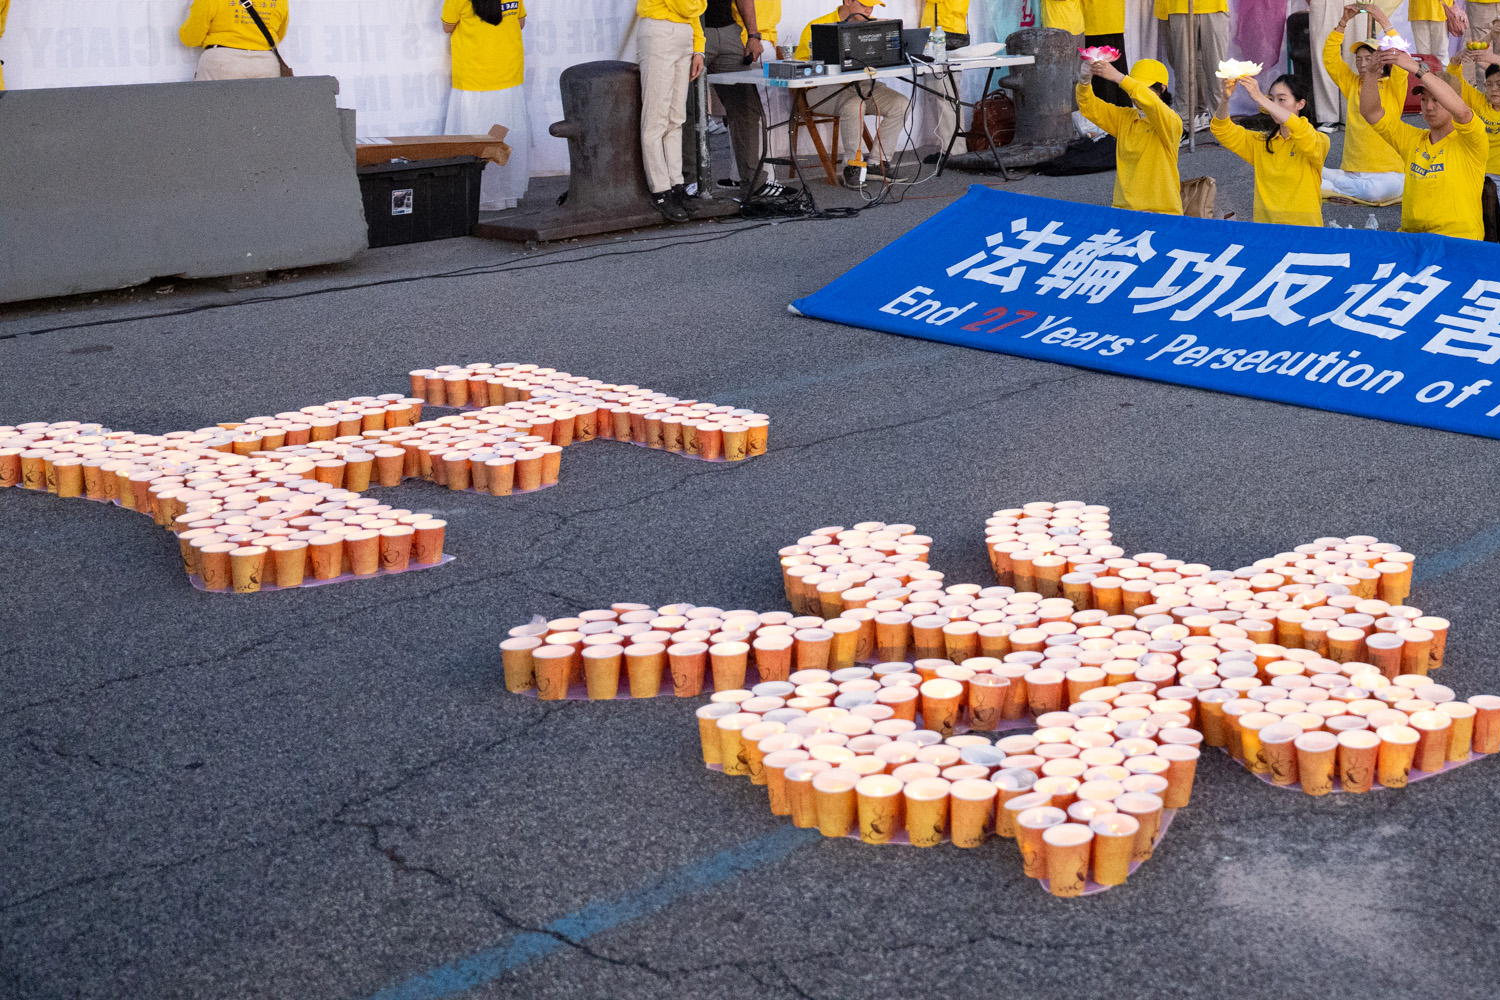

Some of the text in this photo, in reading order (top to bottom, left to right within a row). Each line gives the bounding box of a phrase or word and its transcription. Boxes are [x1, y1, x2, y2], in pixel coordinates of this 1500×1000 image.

[878, 285, 978, 327] End
[960, 306, 1040, 334] 27
[1145, 333, 1405, 396] Persecution
[1415, 379, 1493, 409] of
